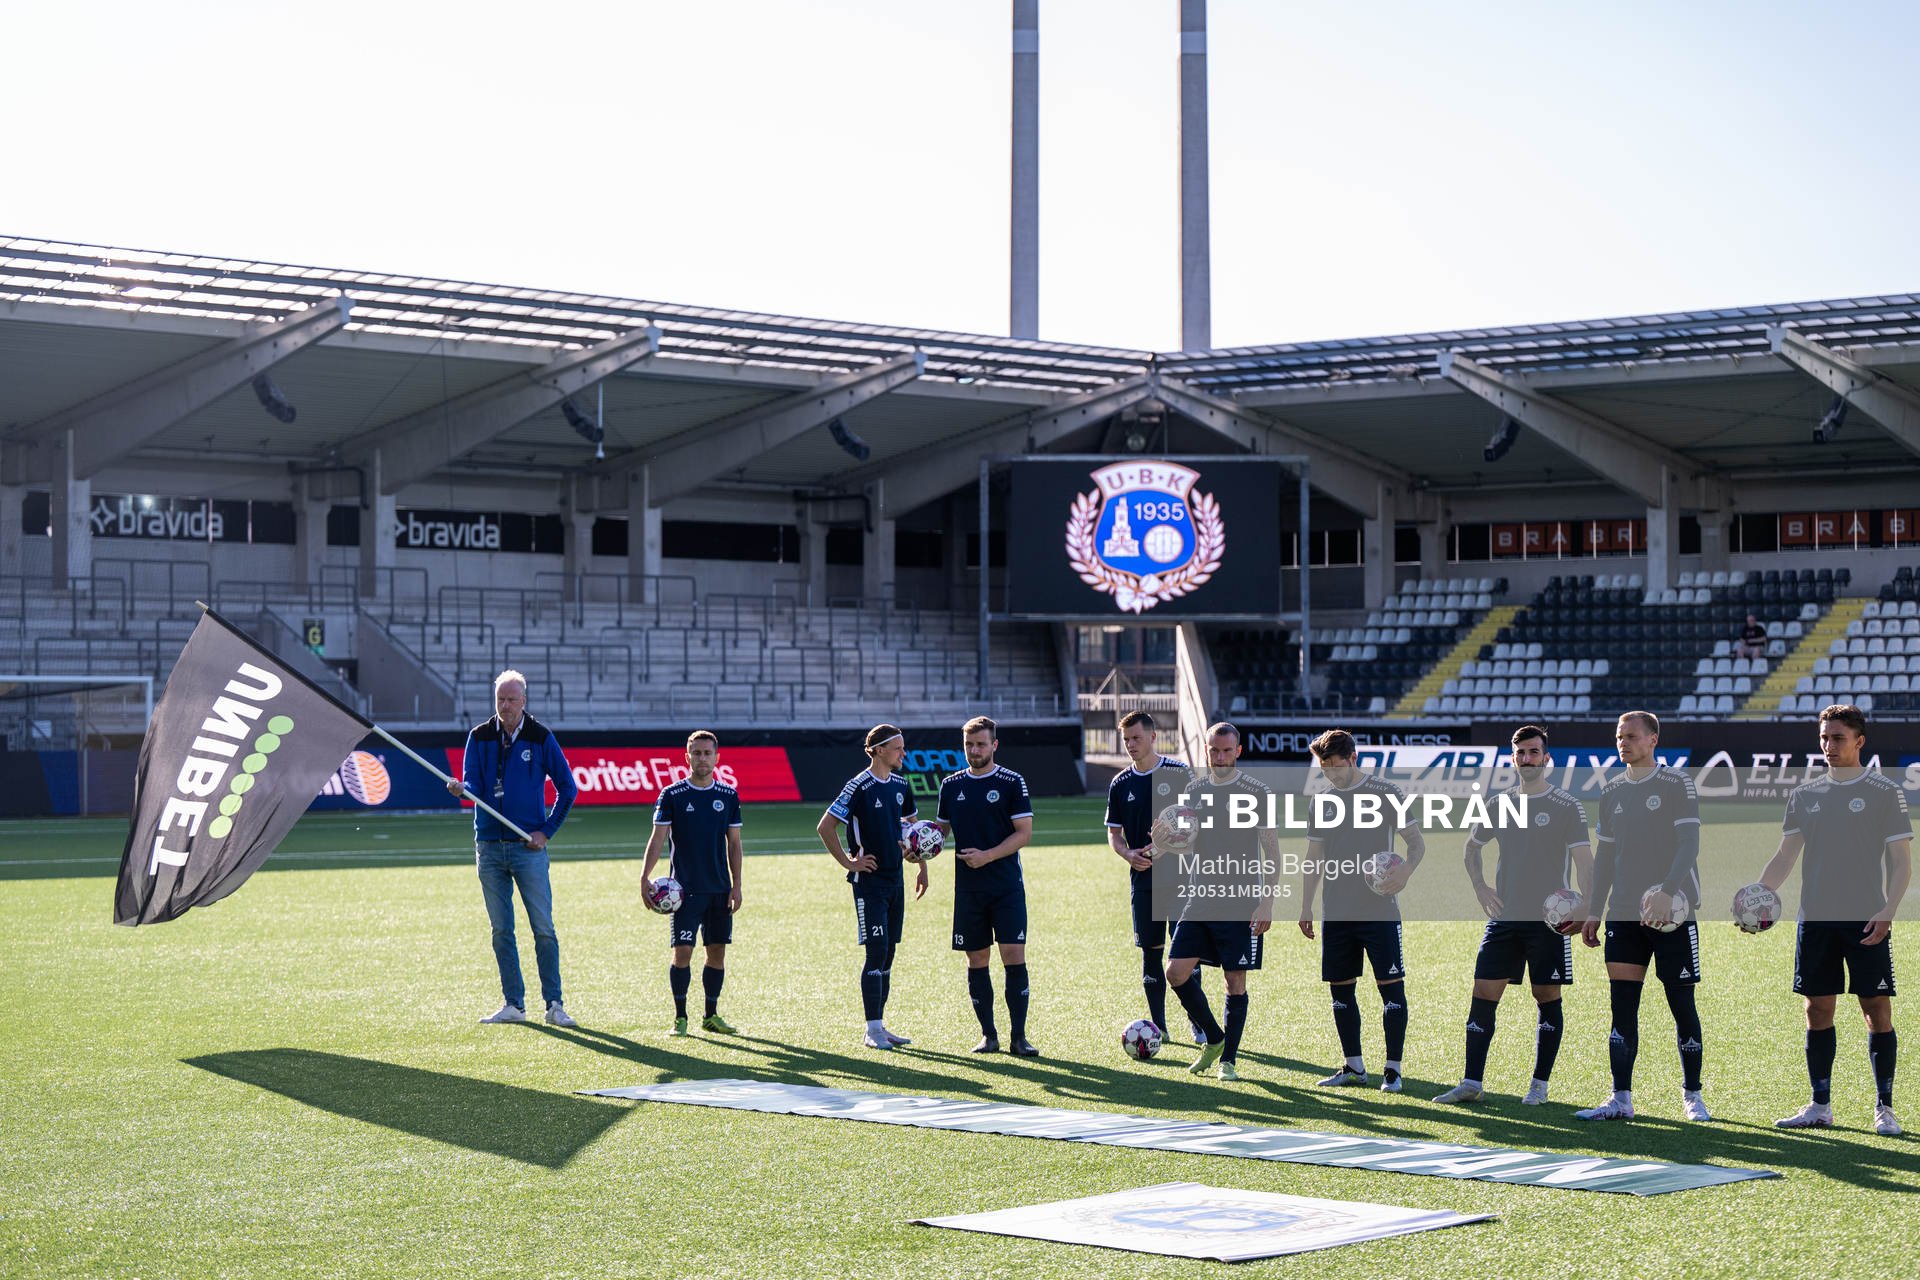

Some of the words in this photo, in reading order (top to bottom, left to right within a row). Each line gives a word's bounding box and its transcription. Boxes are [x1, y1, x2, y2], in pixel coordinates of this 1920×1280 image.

[118, 499, 224, 538] bravida
[1133, 502, 1185, 521] 1935
[408, 512, 500, 549] bravida
[308, 626, 321, 646] G
[901, 750, 968, 772] NORDI
[1746, 752, 1883, 784] ELEA
[680, 930, 693, 941] 22
[871, 925, 884, 936] 21
[954, 933, 964, 945] 13
